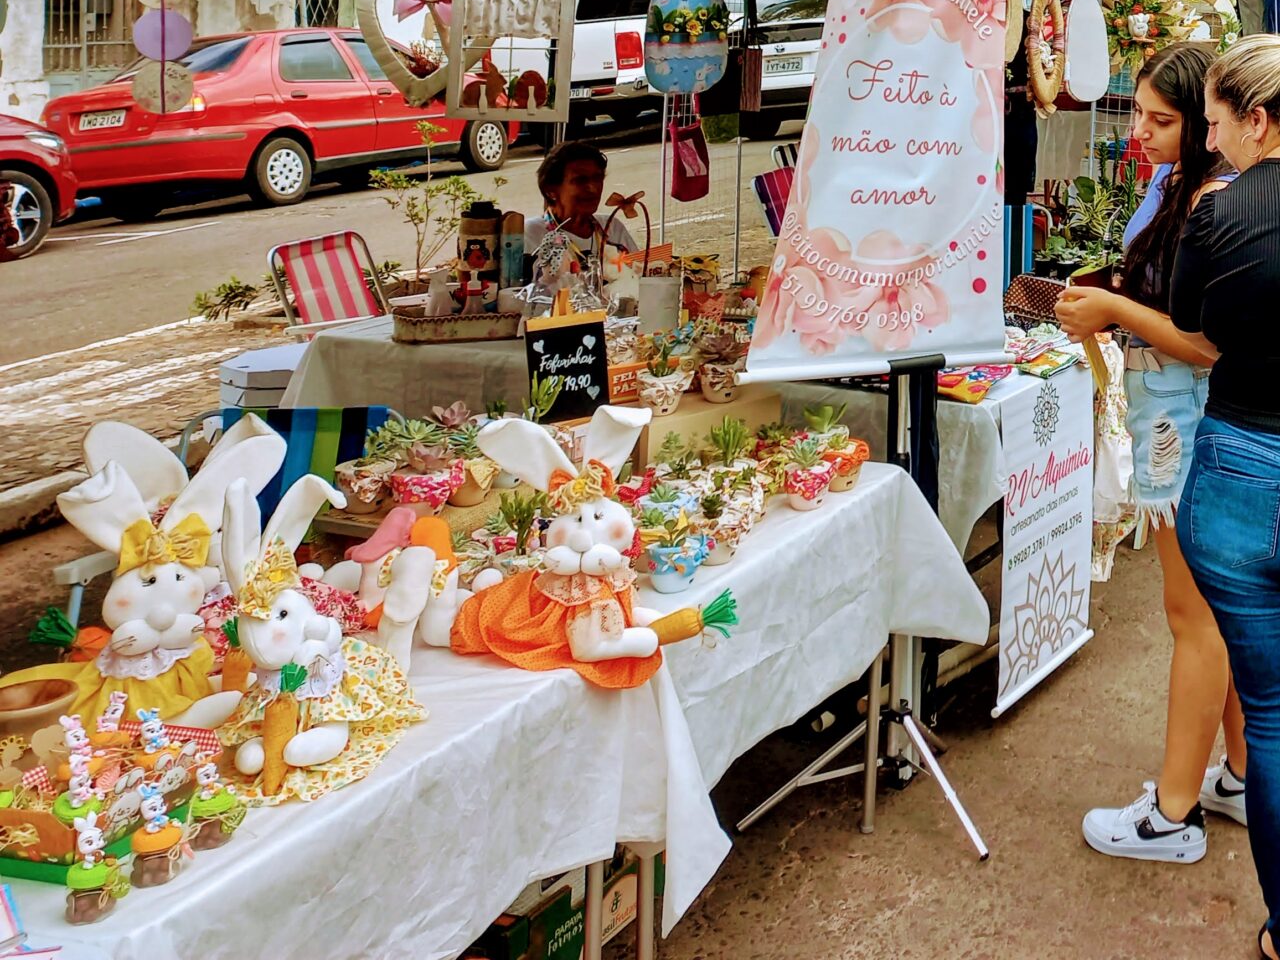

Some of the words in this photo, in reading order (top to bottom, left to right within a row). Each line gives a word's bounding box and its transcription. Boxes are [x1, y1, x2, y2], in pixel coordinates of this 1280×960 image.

[846, 59, 933, 105] Feito
[939, 83, 957, 106] à
[831, 129, 897, 153] mão
[906, 138, 962, 156] com
[850, 186, 936, 206] amor
[781, 274, 802, 296] 51
[800, 290, 869, 331] 99769
[877, 303, 925, 331] 0398
[564, 374, 591, 391] 19,90
[613, 371, 636, 384] FEL
[1032, 441, 1092, 498] Alquimia
[1010, 507, 1045, 536] artesanato
[555, 911, 583, 939] PAPAYA
